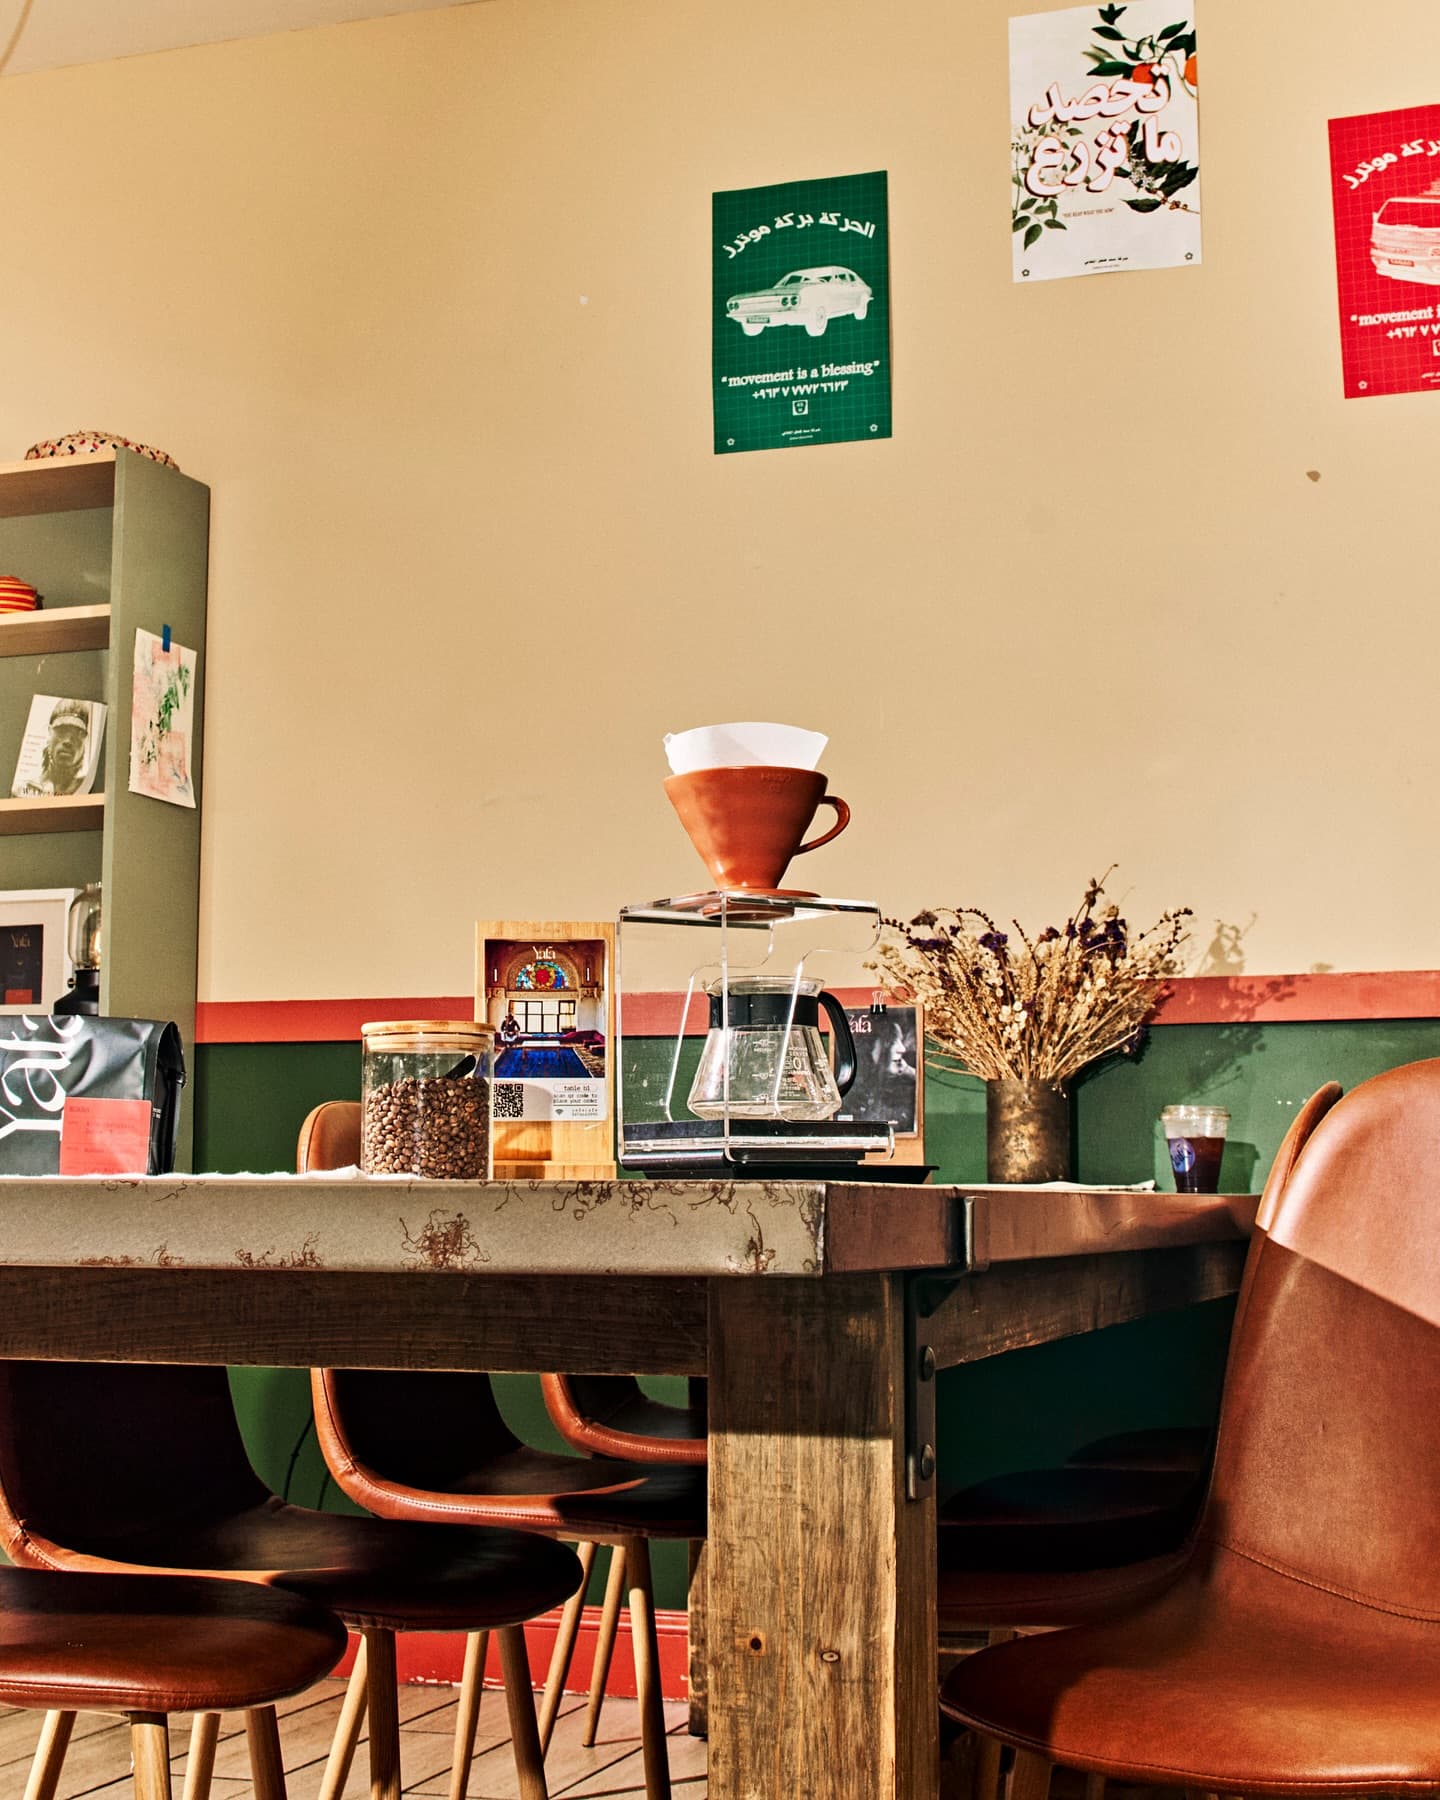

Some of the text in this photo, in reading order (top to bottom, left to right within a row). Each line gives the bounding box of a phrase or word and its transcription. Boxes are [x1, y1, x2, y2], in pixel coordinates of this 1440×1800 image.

[1027, 62, 1170, 129] تحصد
[1025, 115, 1183, 197] ما تزرع
[722, 211, 876, 259] الحركة بركة موترز
[796, 367, 807, 381] is
[810, 369, 819, 378] a
[532, 945, 556, 960] Yafa
[848, 1015, 872, 1033] afa
[563, 1084, 581, 1092] table
